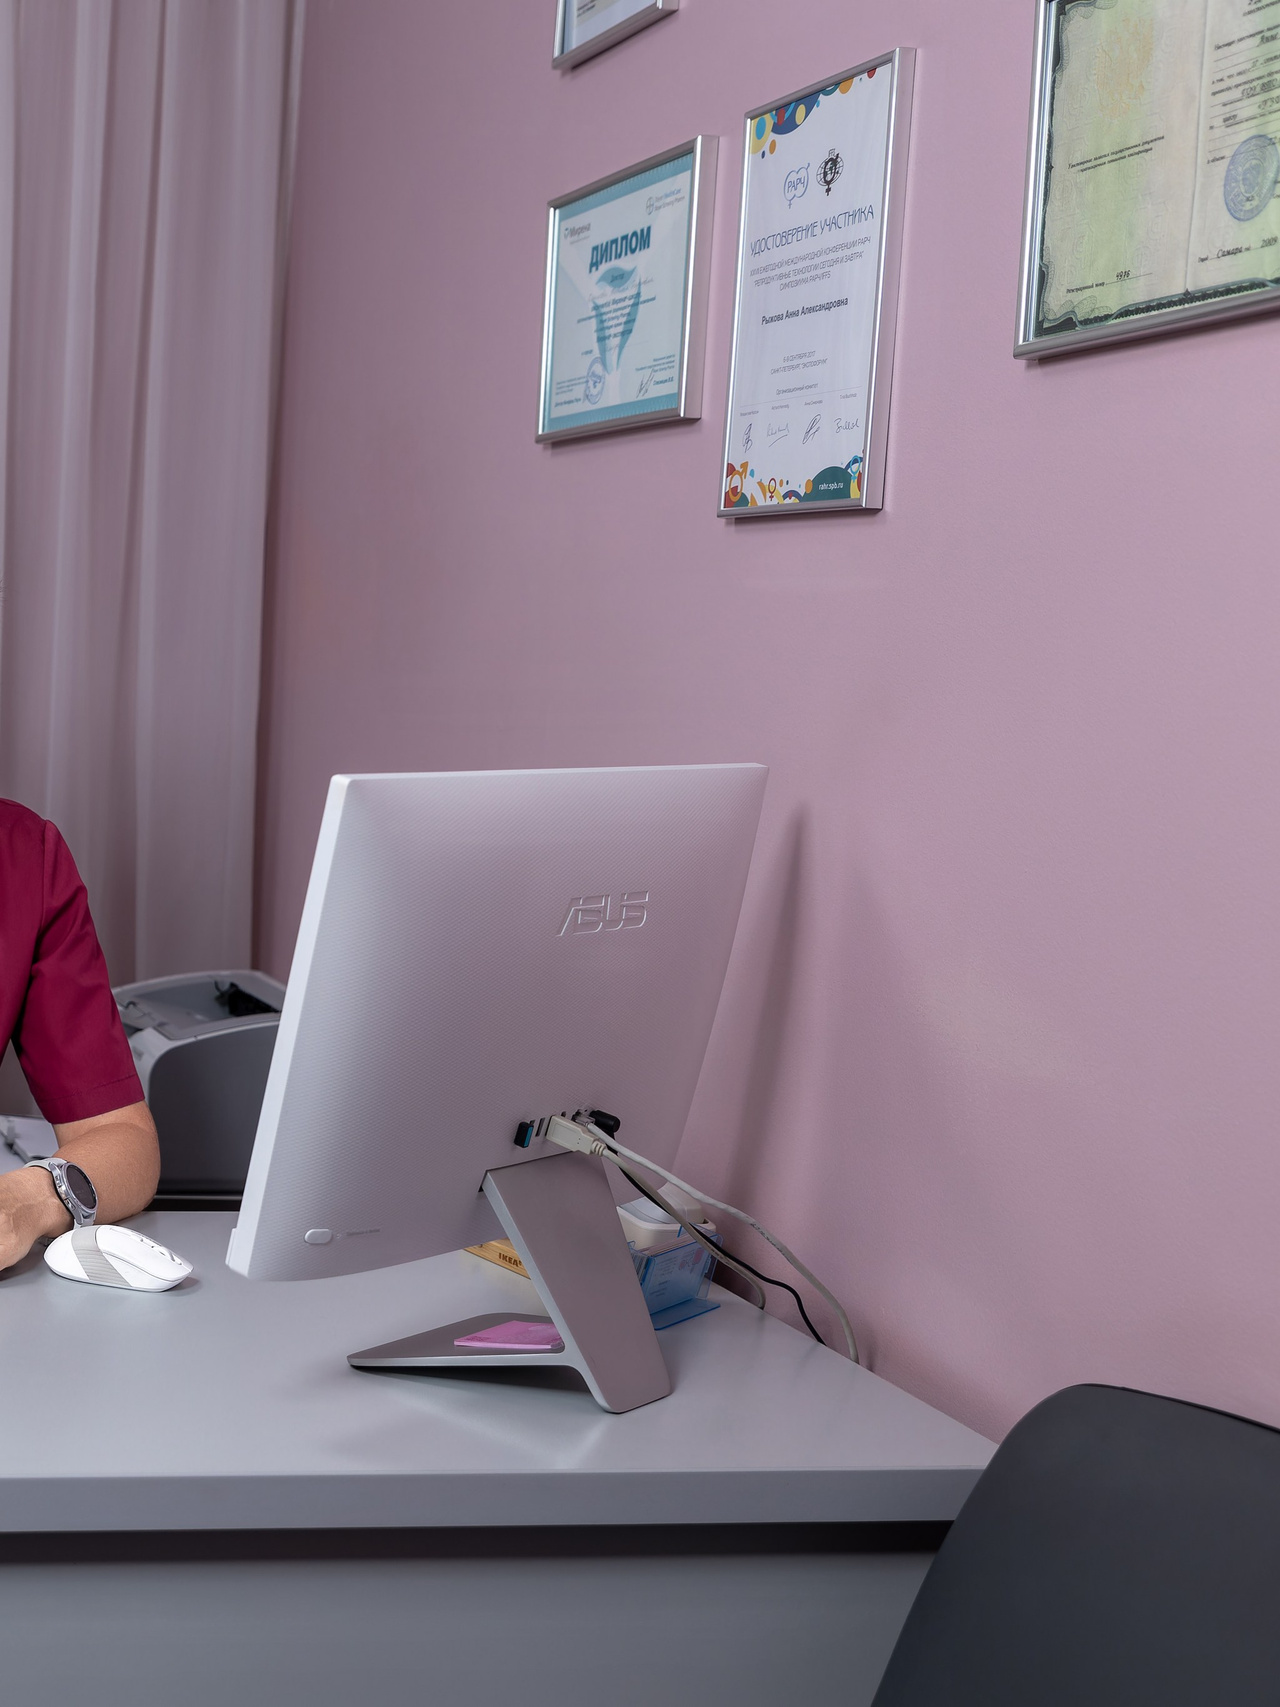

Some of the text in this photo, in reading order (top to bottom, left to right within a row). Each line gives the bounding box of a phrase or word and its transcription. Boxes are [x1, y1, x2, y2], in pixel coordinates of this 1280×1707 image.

[787, 176, 806, 193] РАРЧ
[750, 204, 874, 257] УДОСТОВЕРЕНИЕ УЧАСТНИКА
[589, 225, 651, 274] ДИПЛОМ
[1216, 246, 1243, 259] Самара
[761, 297, 848, 325] Рыжова Анна Александровна
[818, 482, 844, 491] rahr.spb.ru
[556, 890, 649, 937] ASUS
[498, 1253, 519, 1267] IKEA
